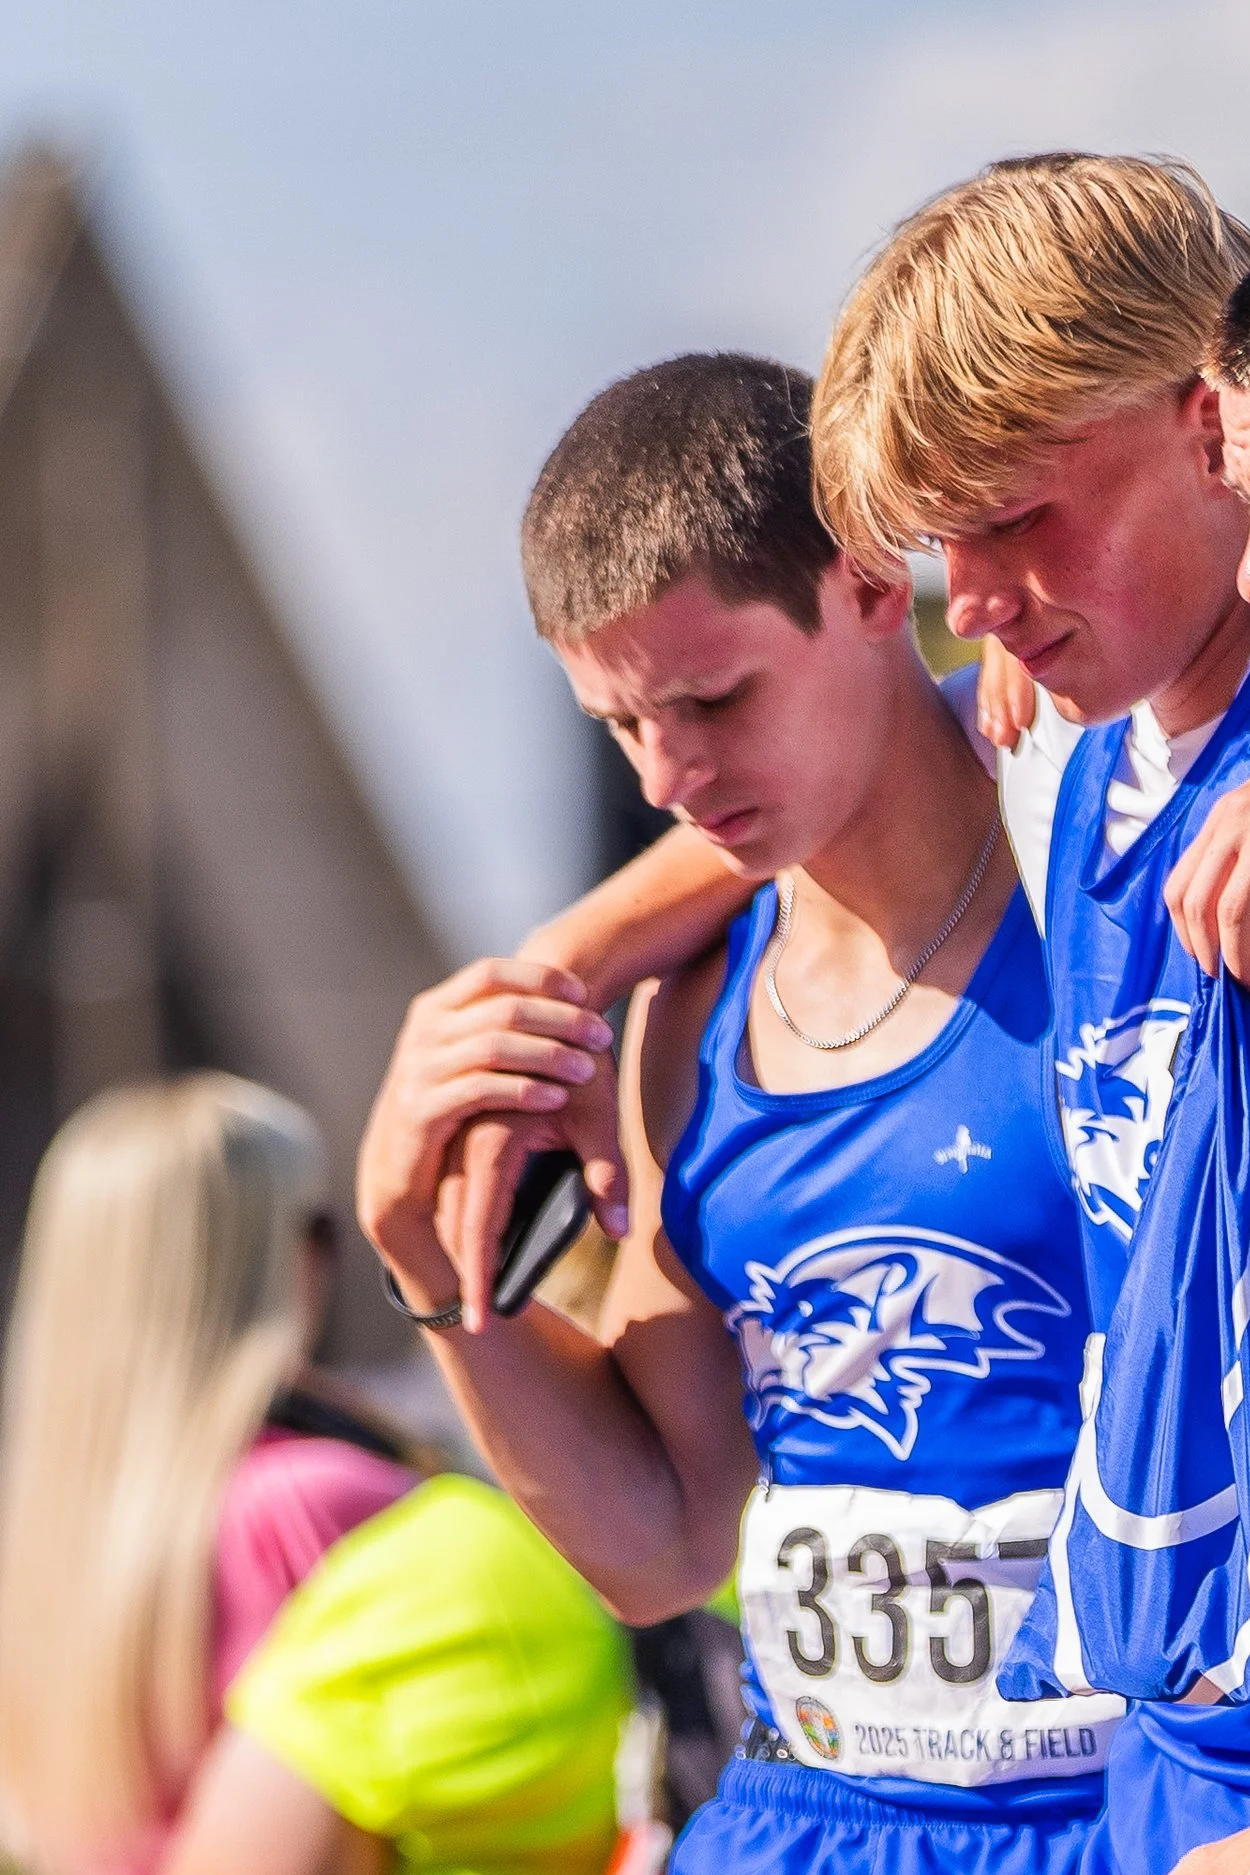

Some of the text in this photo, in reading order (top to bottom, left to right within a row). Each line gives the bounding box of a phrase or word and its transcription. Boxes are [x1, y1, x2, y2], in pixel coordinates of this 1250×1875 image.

[777, 1526, 1048, 1684] 335
[854, 1724, 1097, 1762] 2025 TRACK & FIELD
